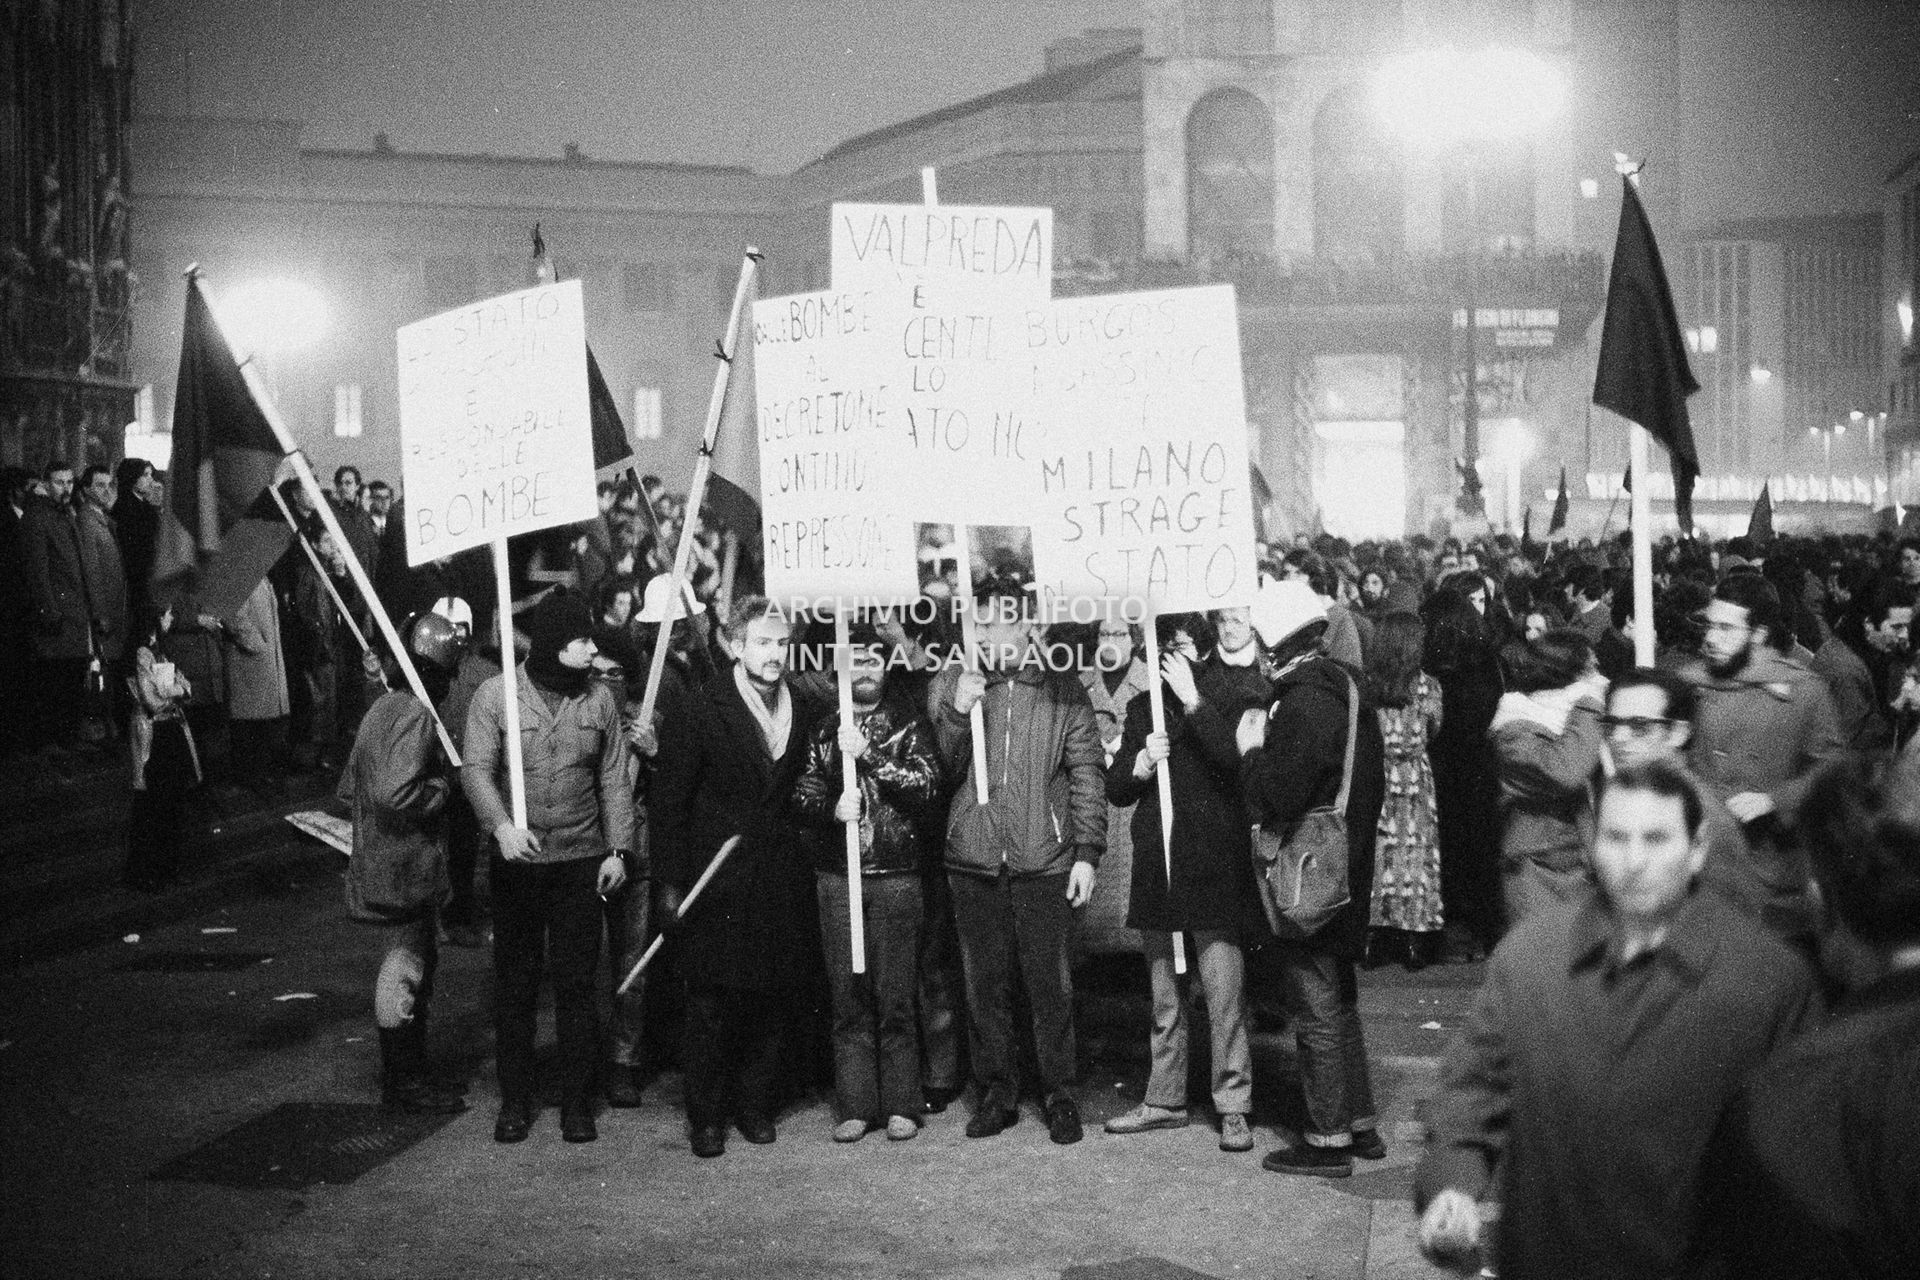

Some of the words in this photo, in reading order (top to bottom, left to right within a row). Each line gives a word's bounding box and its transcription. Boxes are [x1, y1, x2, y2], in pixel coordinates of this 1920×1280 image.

[844, 213, 1042, 278] VALPREDA
[790, 291, 872, 343] BOMBE
[1026, 298, 1176, 348] BURGOS
[913, 364, 946, 392] LO
[1042, 440, 1227, 494] MILANO
[417, 471, 552, 546] BOMBE
[1063, 488, 1236, 542] STRAGE
[1086, 543, 1237, 600] STATO
